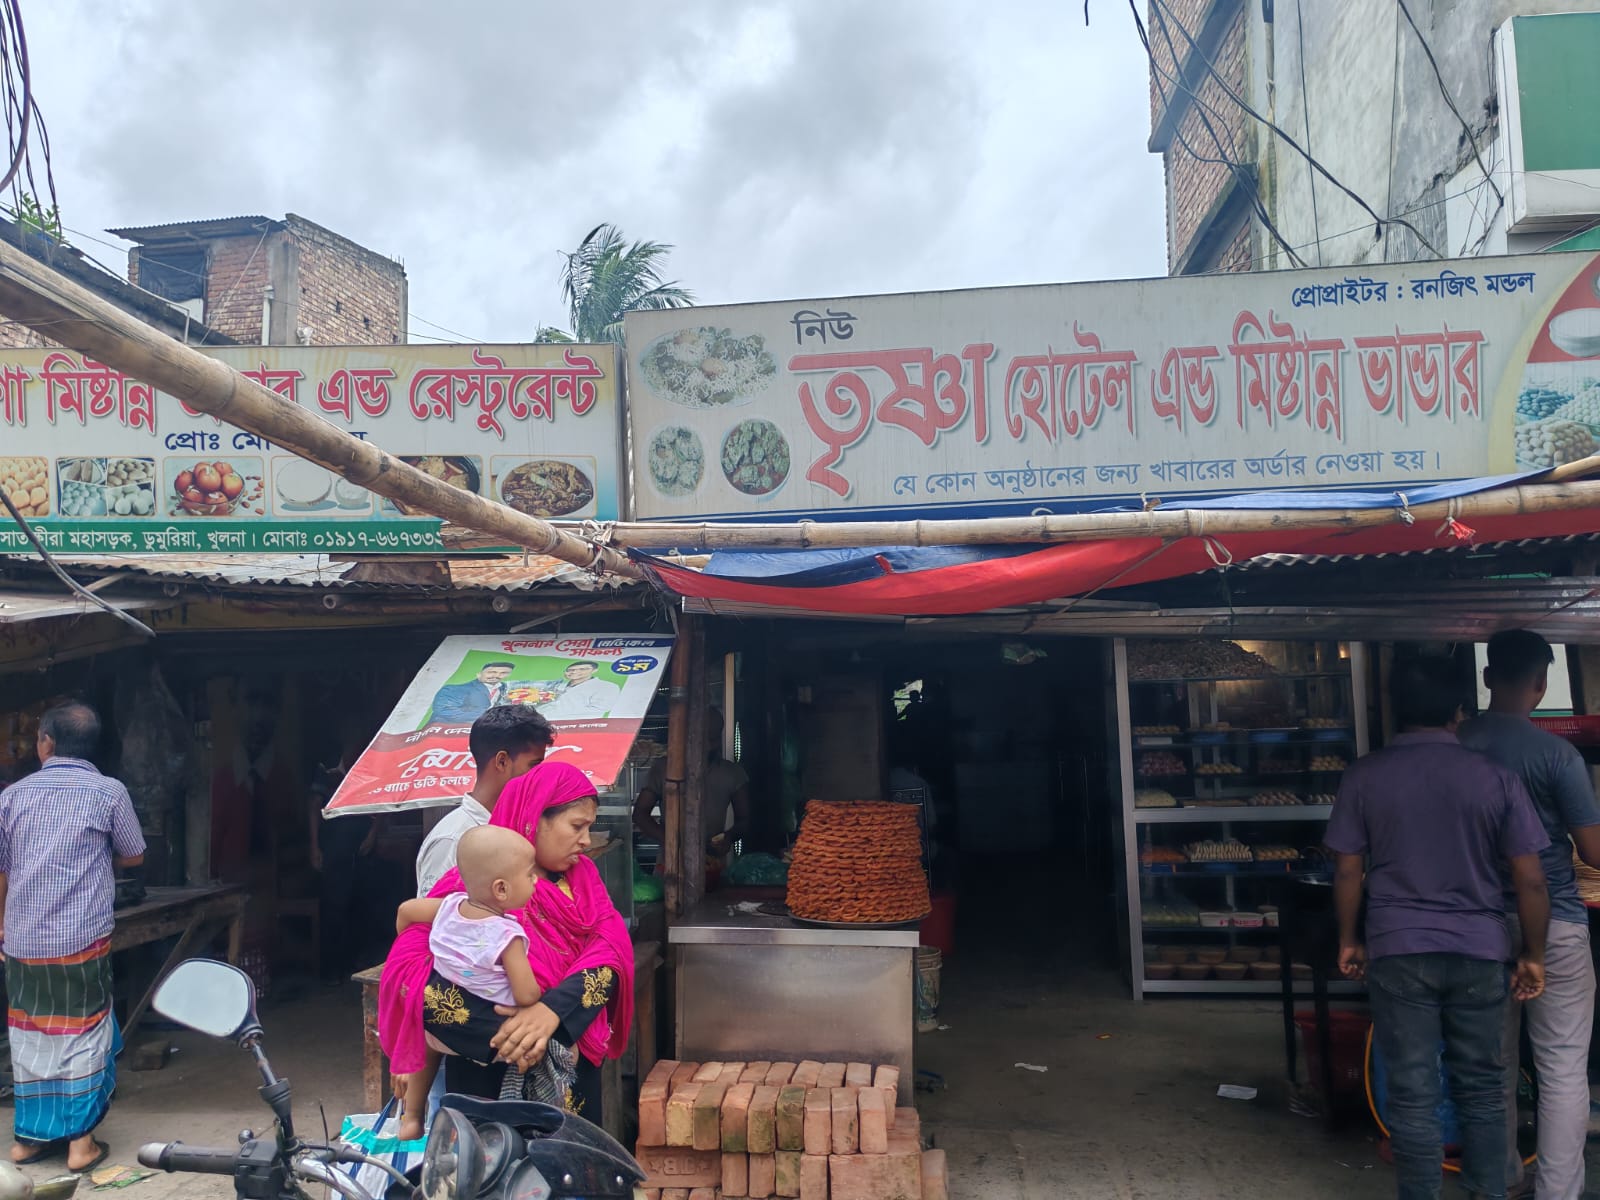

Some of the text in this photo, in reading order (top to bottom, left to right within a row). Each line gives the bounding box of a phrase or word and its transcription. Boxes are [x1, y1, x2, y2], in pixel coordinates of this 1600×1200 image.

[1292, 276, 1388, 307] প্রোপ্রাইটর
[1411, 270, 1478, 300] রনজিৎ
[1484, 272, 1536, 295] মন্ডল
[790, 310, 857, 344] নিউ
[316, 367, 397, 424] এন্ড
[408, 348, 604, 440] রেস্টুরেন্ট
[787, 309, 1485, 499] তৃষ্ণা হোটেল এন্ড মিষ্টান্ন ভান্ডার
[165, 431, 220, 452] প্রোঃ
[893, 475, 918, 496] যে
[925, 472, 977, 493] কোন
[984, 460, 1087, 494] অনুষ্ঠানের
[1094, 463, 1141, 485] জন্য
[1150, 458, 1236, 482] খাবারের
[1244, 449, 1307, 477] অর্ডার
[1315, 450, 1384, 476] নেওয়া
[1391, 450, 1426, 472] হয়
[68, 528, 138, 550] মহাসড়ক,
[207, 530, 247, 551] খুলনা
[262, 530, 308, 548] মোবাঃ
